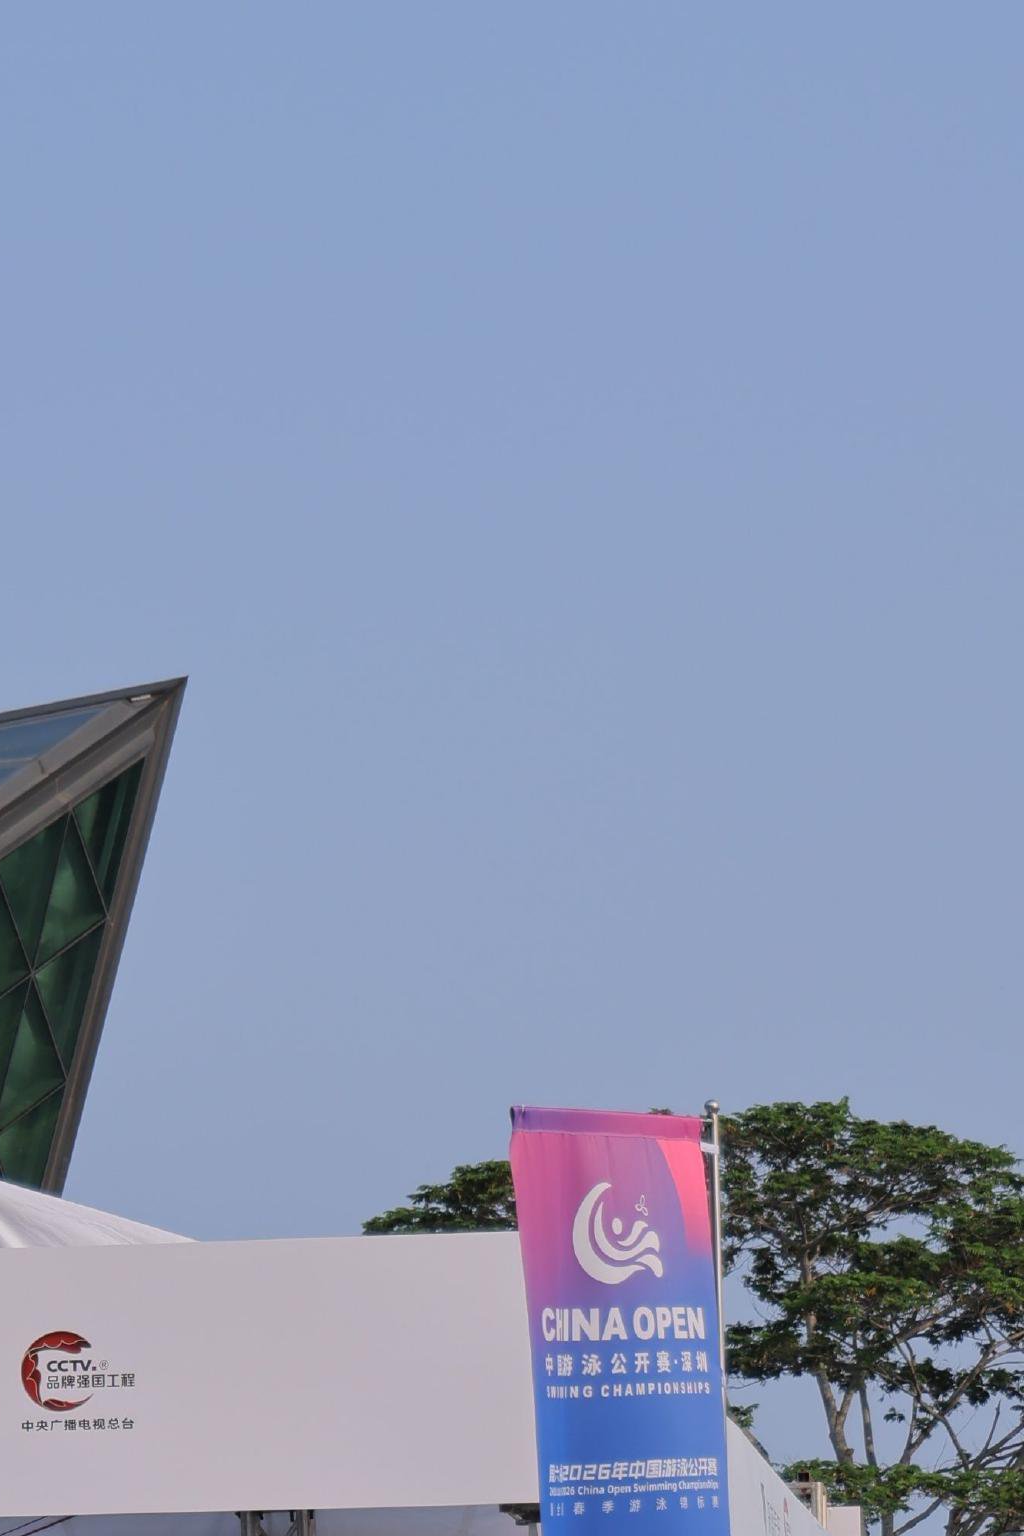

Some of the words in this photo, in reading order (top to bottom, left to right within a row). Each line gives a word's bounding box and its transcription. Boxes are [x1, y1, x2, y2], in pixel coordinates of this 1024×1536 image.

[542, 1307, 628, 1342] CHINA
[633, 1306, 705, 1340] OPEN
[46, 1373, 136, 1389] 品牌强国工程
[601, 1382, 710, 1398] CHAMPIONSHIPS
[21, 1418, 135, 1432] 中央广播电视总台
[578, 1486, 605, 1496] China
[608, 1485, 631, 1496] Open
[633, 1481, 677, 1493] Swimming
